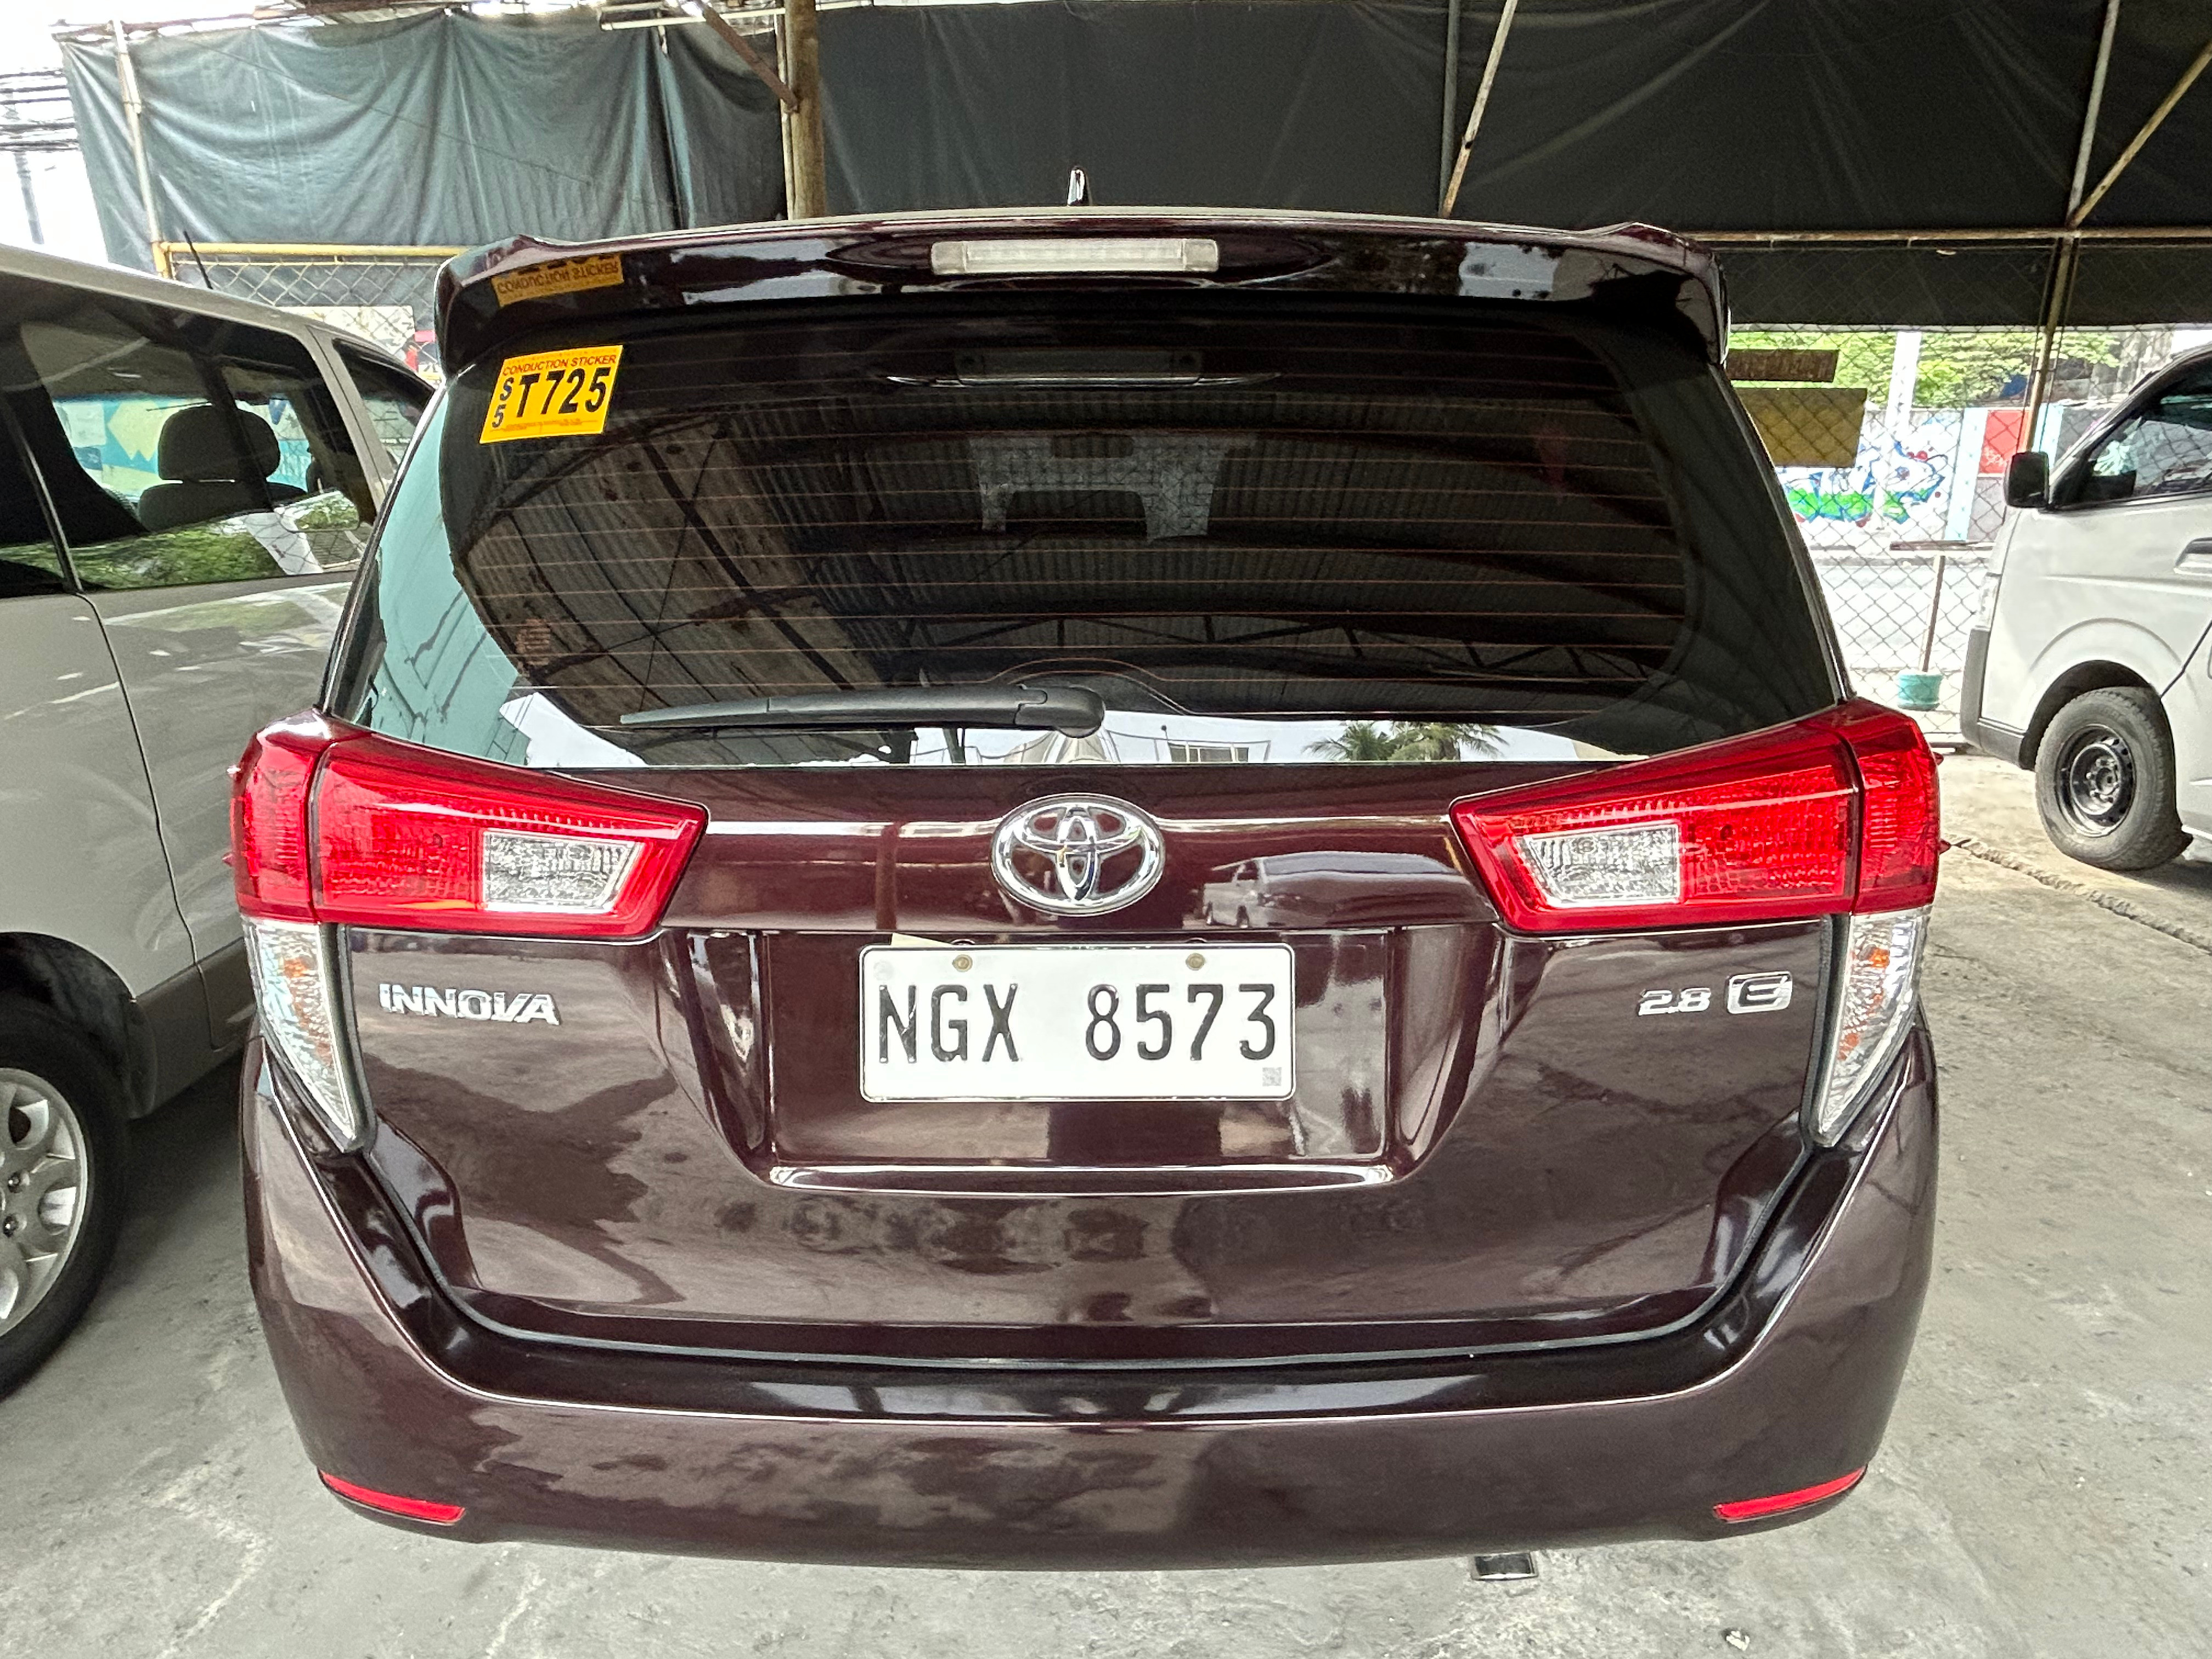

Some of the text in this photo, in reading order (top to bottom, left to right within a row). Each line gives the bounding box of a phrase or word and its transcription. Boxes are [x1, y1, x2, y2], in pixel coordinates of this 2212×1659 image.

[503, 358, 568, 376] CONDUCTION
[571, 354, 617, 366] STICKER
[516, 367, 611, 417] T725
[379, 983, 562, 1025] INNOVA
[879, 983, 1277, 1063] NGX 8573
[1637, 988, 1712, 1016] 2.8
